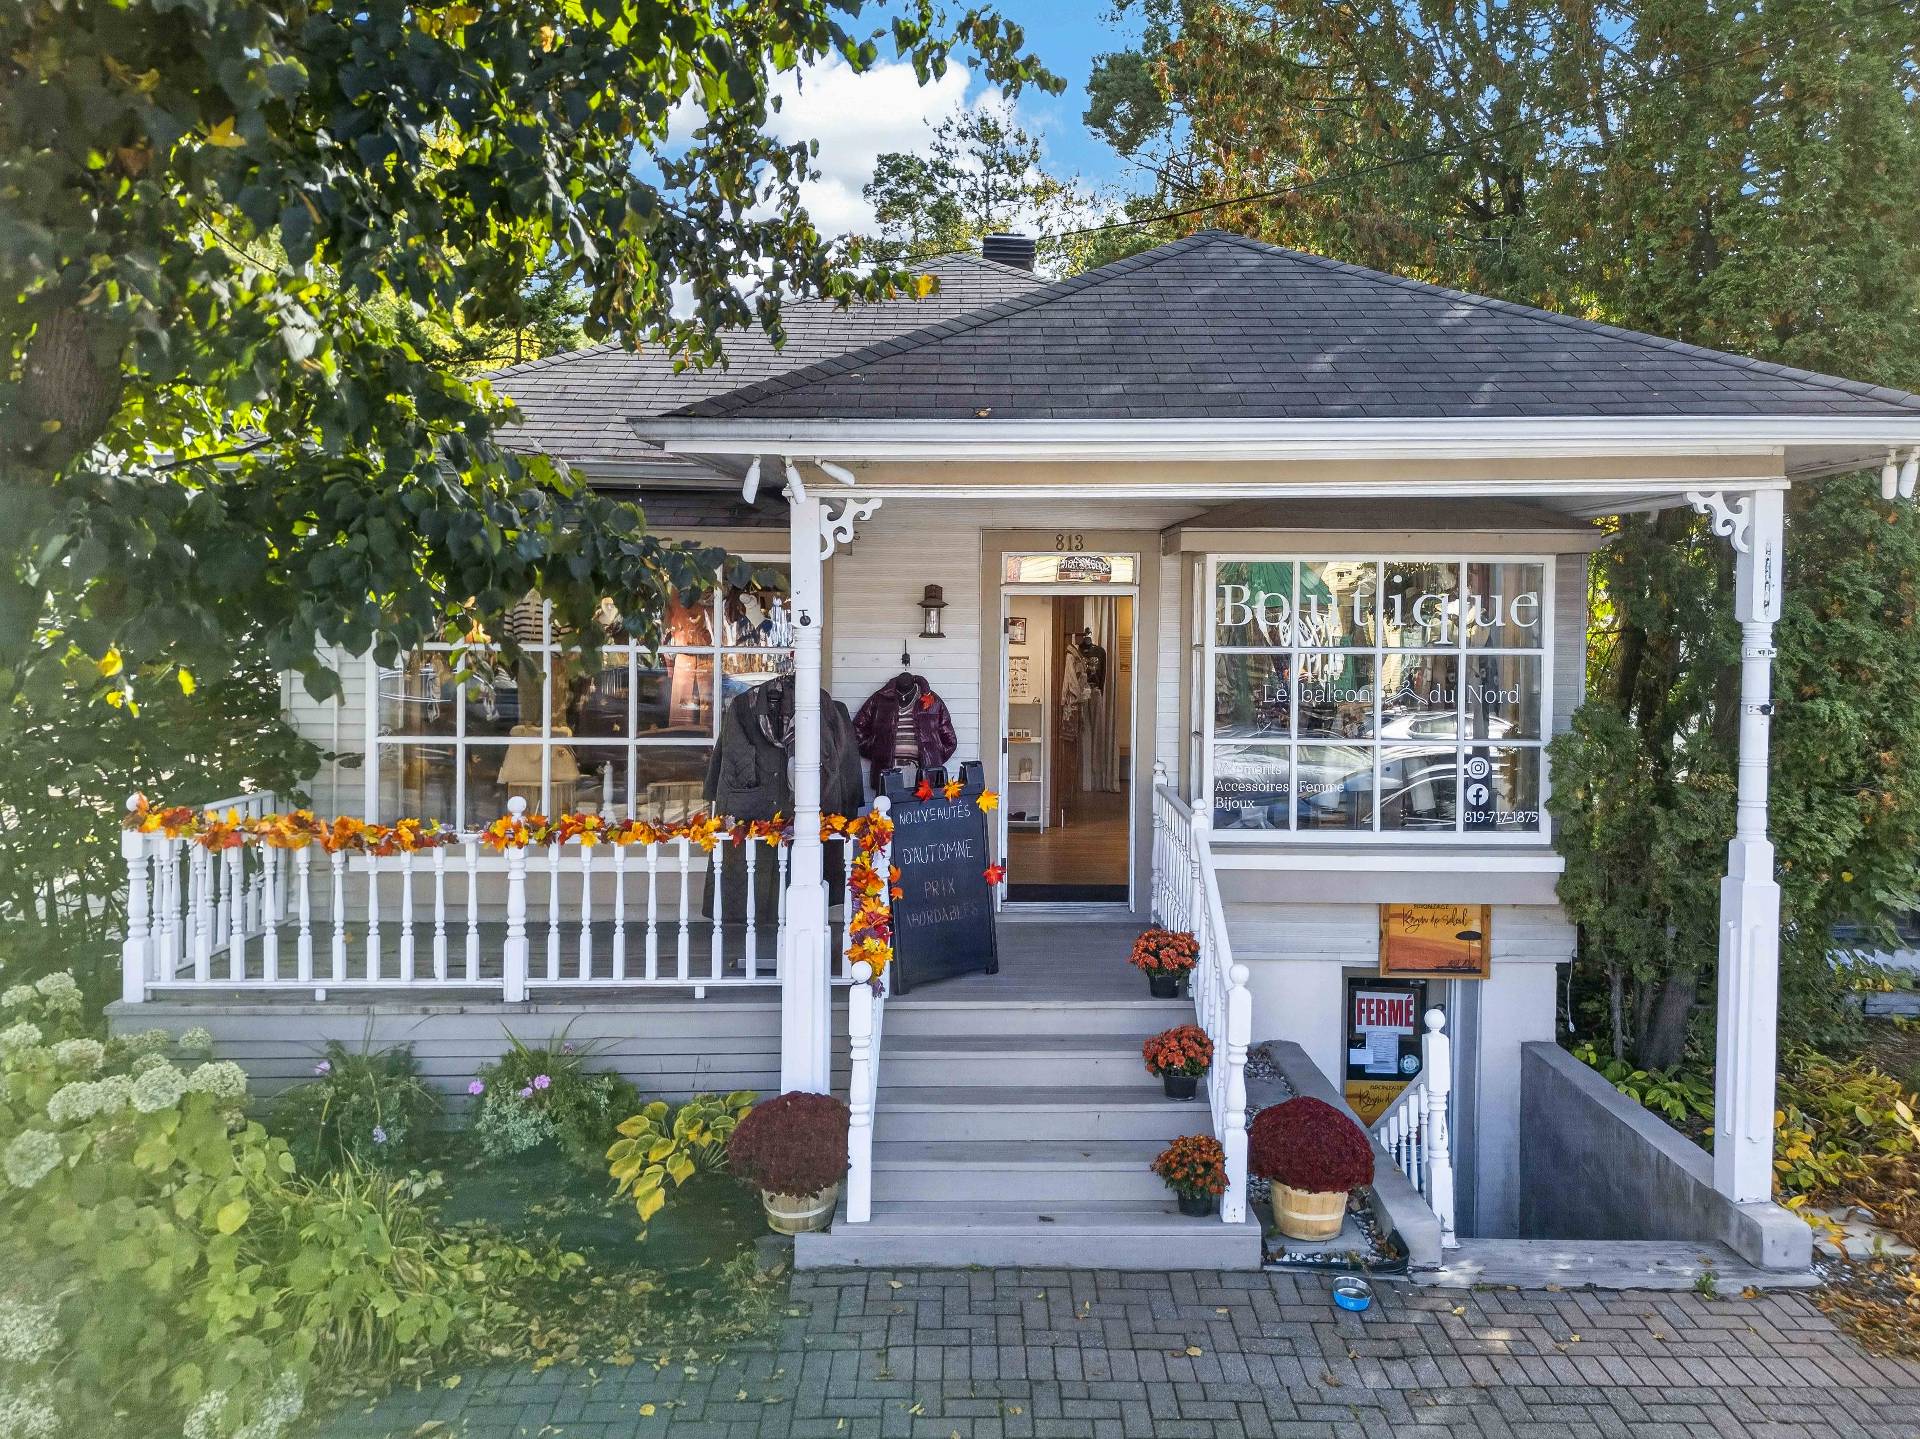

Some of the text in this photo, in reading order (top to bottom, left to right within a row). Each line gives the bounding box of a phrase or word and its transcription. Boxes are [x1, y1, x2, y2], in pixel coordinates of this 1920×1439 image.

[1056, 534, 1084, 551] 813
[1217, 574, 1539, 646] Boutique
[1301, 683, 1370, 703] balcon
[1430, 683, 1455, 703] du
[1468, 683, 1520, 703] Nord
[1215, 780, 1345, 793] Accessoires Femme
[899, 801, 971, 825] NOUVEAUTÉS
[1215, 797, 1255, 811] Bijoux
[1464, 811, 1539, 825] 819-717-1875
[902, 838, 974, 865] D'AUTOMNE
[924, 878, 956, 898] PRIX
[1356, 994, 1414, 1027] FERMÉ
